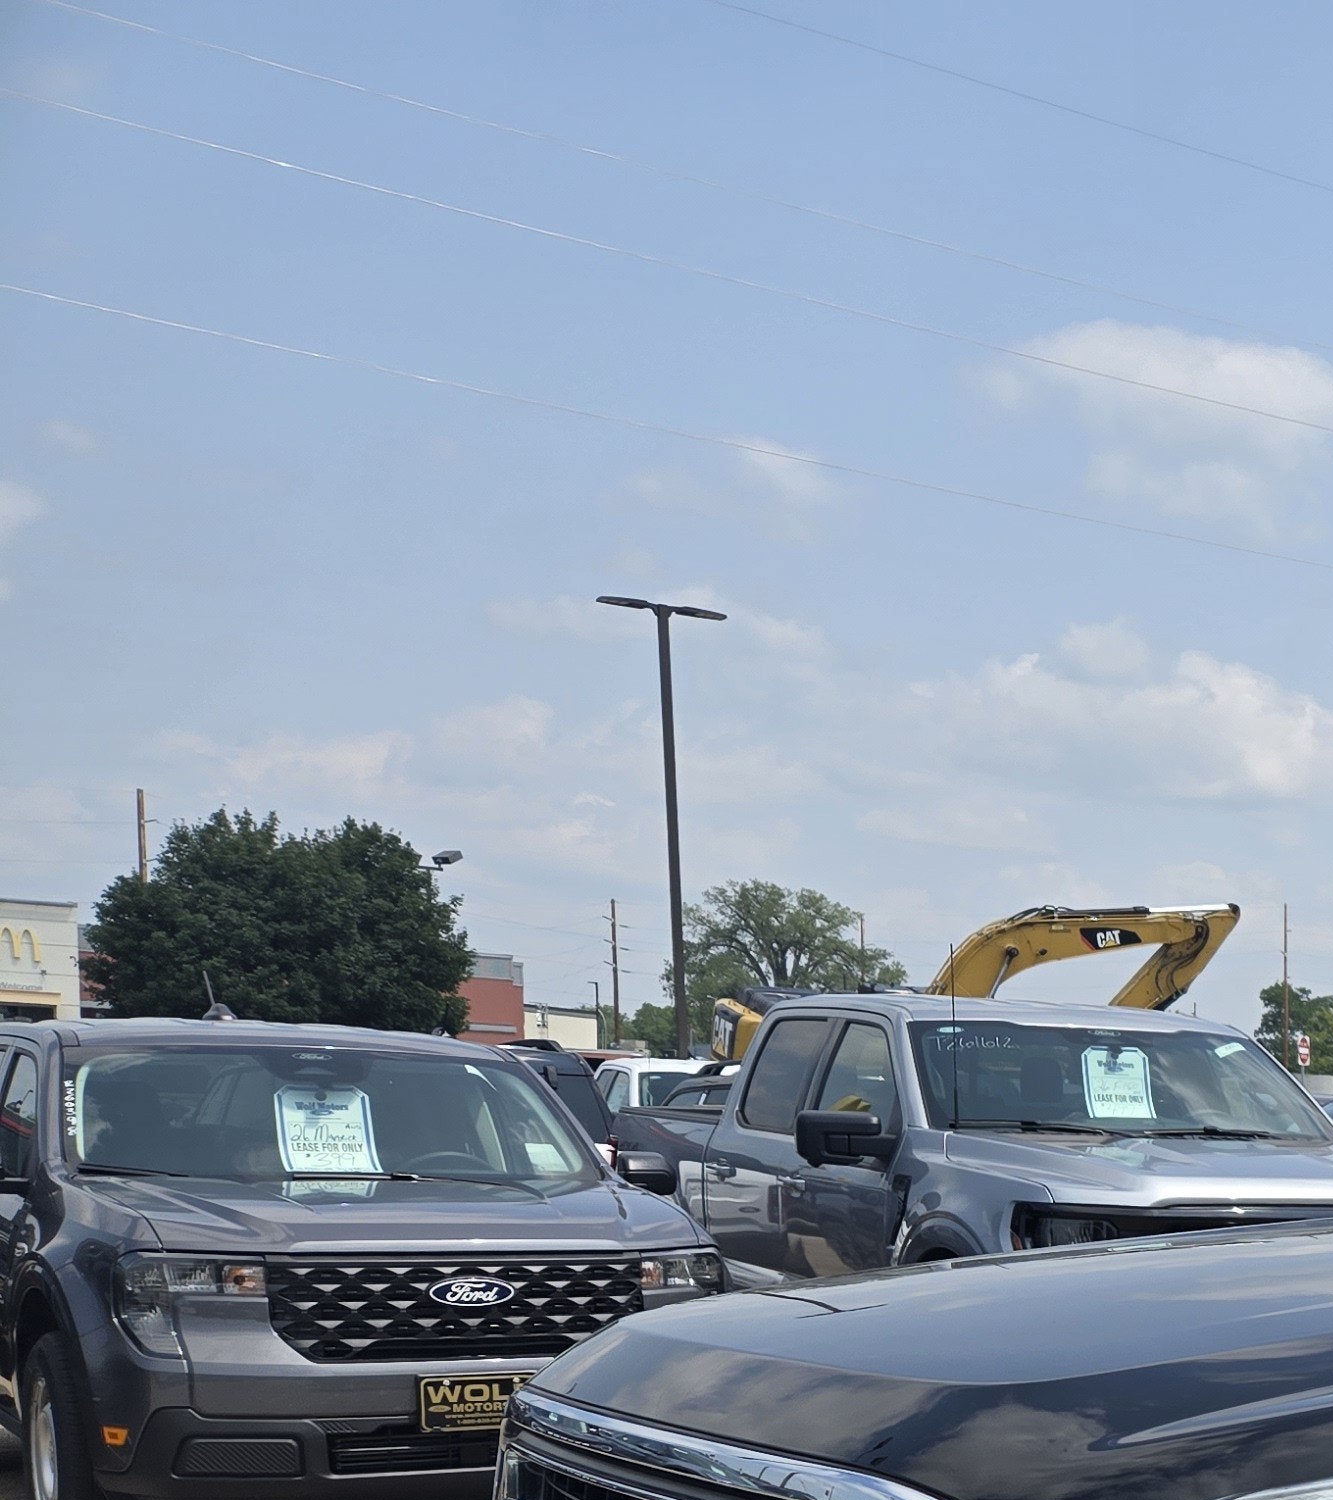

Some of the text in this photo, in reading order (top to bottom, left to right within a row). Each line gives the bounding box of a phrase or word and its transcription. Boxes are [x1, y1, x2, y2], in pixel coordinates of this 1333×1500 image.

[1096, 930, 1120, 948] CAT
[295, 1101, 349, 1111] Wolf Motors
[291, 1142, 364, 1153] LEASE FOR ONLY
[446, 1281, 498, 1302] Ford
